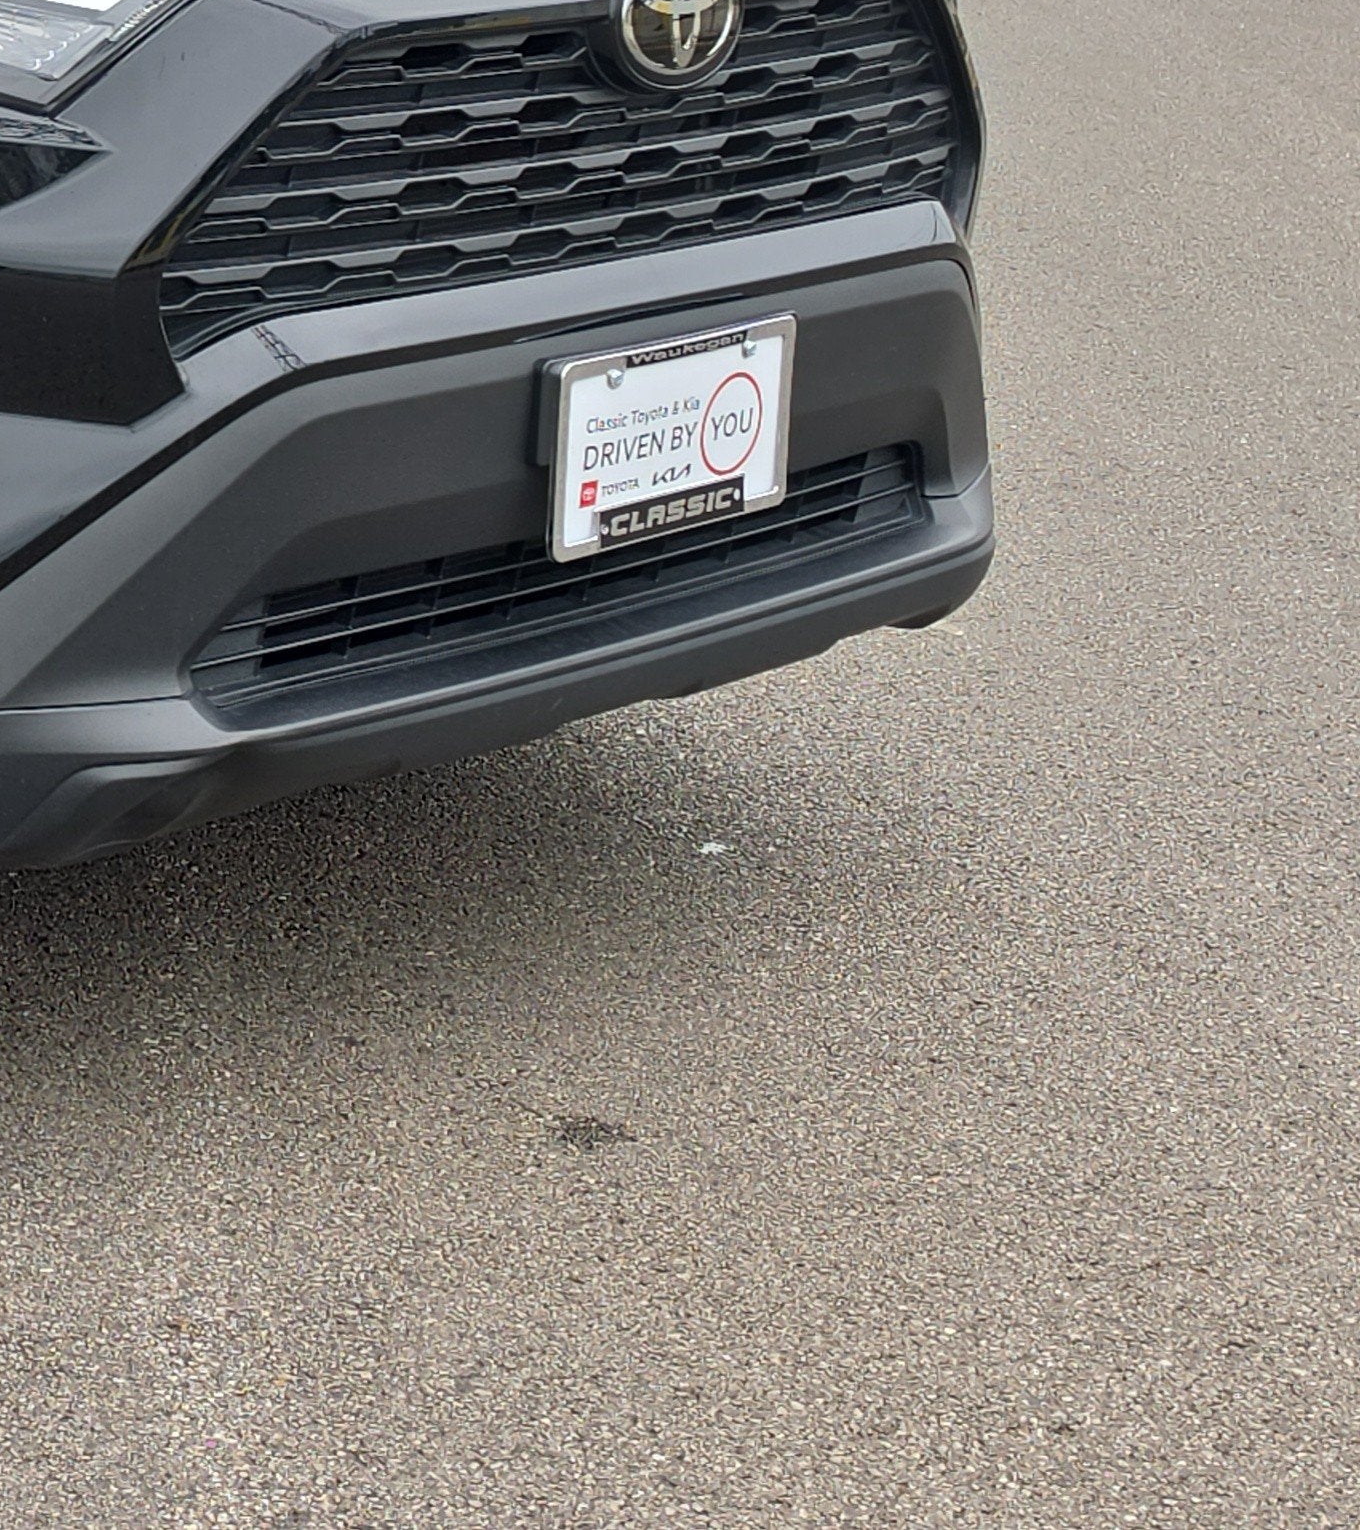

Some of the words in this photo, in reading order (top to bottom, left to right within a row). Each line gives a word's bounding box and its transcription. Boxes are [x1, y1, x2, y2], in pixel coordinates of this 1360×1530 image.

[631, 332, 744, 365] Waukegan
[586, 412, 628, 434] Classic
[631, 405, 669, 426] Toyota
[671, 400, 680, 415] &
[683, 396, 700, 413] Kia
[583, 428, 666, 472] DRIVEN
[670, 421, 699, 451] BY
[710, 406, 754, 441] YOU
[601, 478, 640, 498] TOYOTA
[609, 486, 735, 537] CLASSIC
